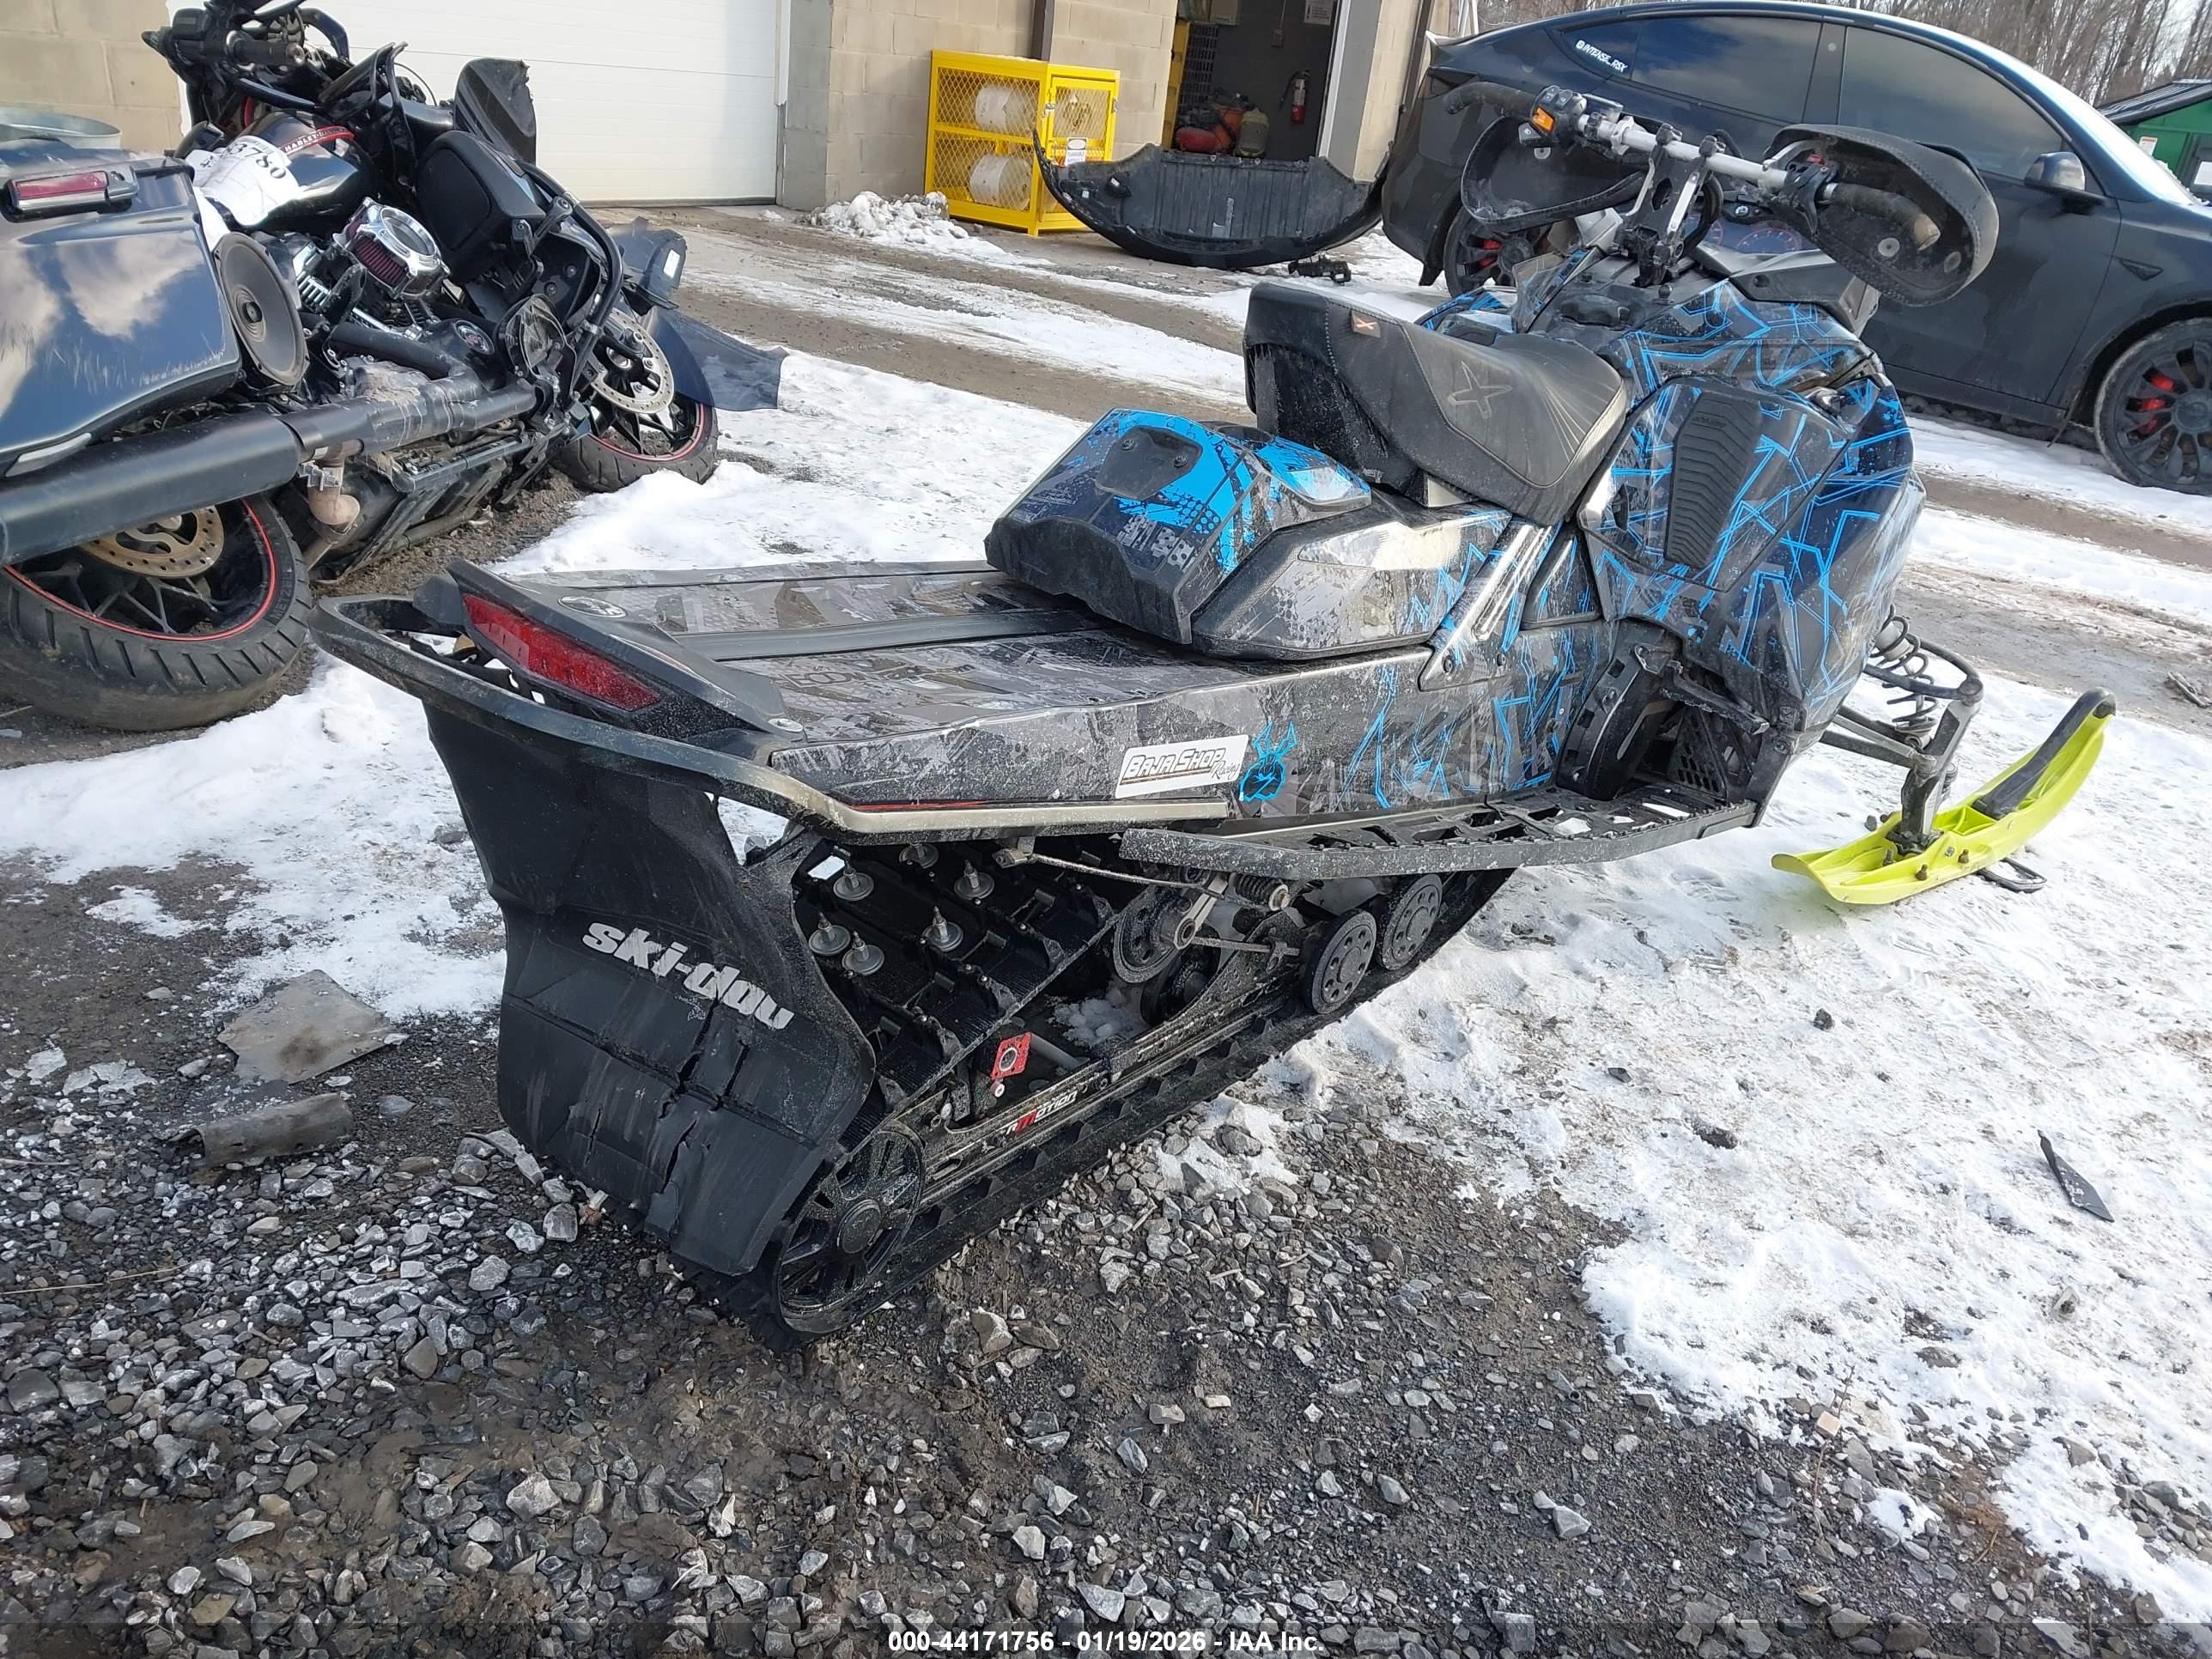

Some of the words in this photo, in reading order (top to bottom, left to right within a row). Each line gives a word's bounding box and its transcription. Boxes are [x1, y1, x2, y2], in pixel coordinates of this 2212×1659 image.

[283, 126, 349, 153] HARLEY-DA
[1123, 753, 1176, 778] BAJA
[1176, 748, 1226, 774] SHOP
